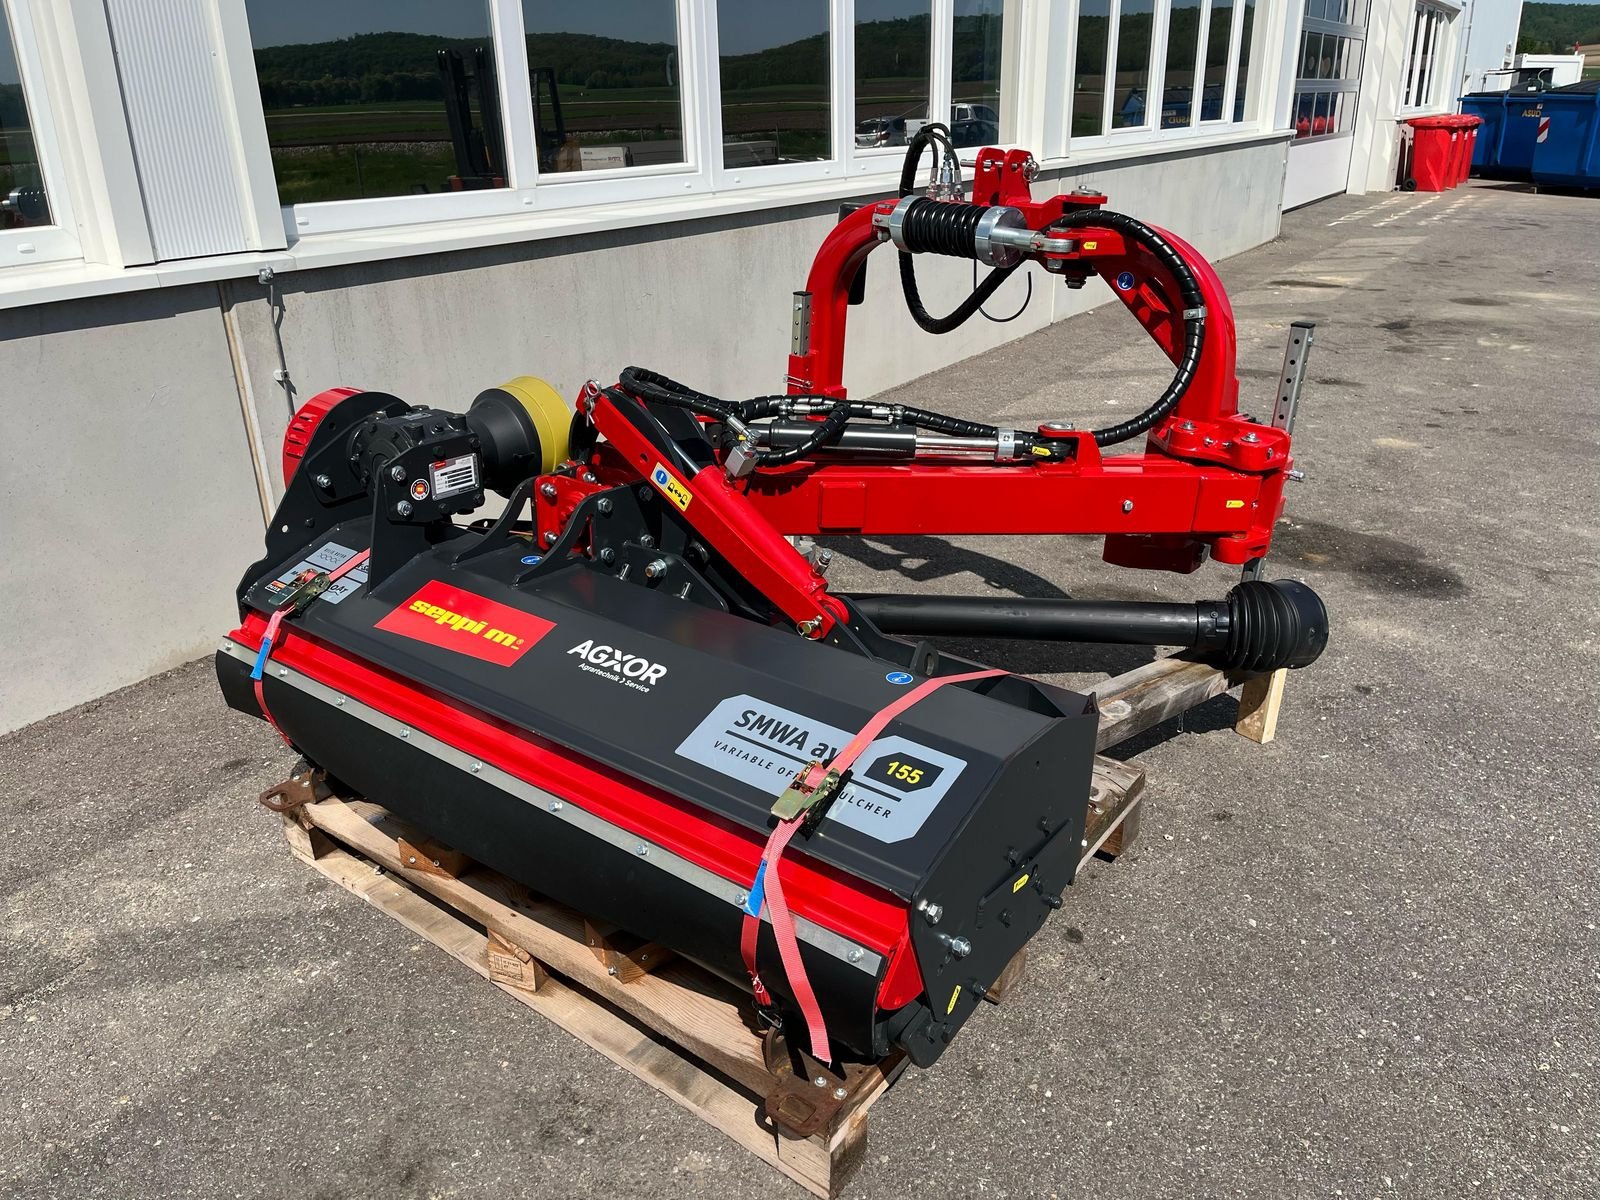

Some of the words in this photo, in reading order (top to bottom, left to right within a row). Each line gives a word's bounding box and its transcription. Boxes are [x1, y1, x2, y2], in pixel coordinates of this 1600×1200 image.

[409, 600, 488, 634] seppi
[567, 640, 668, 685] AGXOR
[578, 662, 621, 682] Agrartechnik
[624, 680, 650, 693] Service
[733, 709, 810, 751] SMWA
[713, 740, 774, 770] VARIABLE
[838, 791, 892, 818] ULCHER
[886, 761, 924, 784] 155
